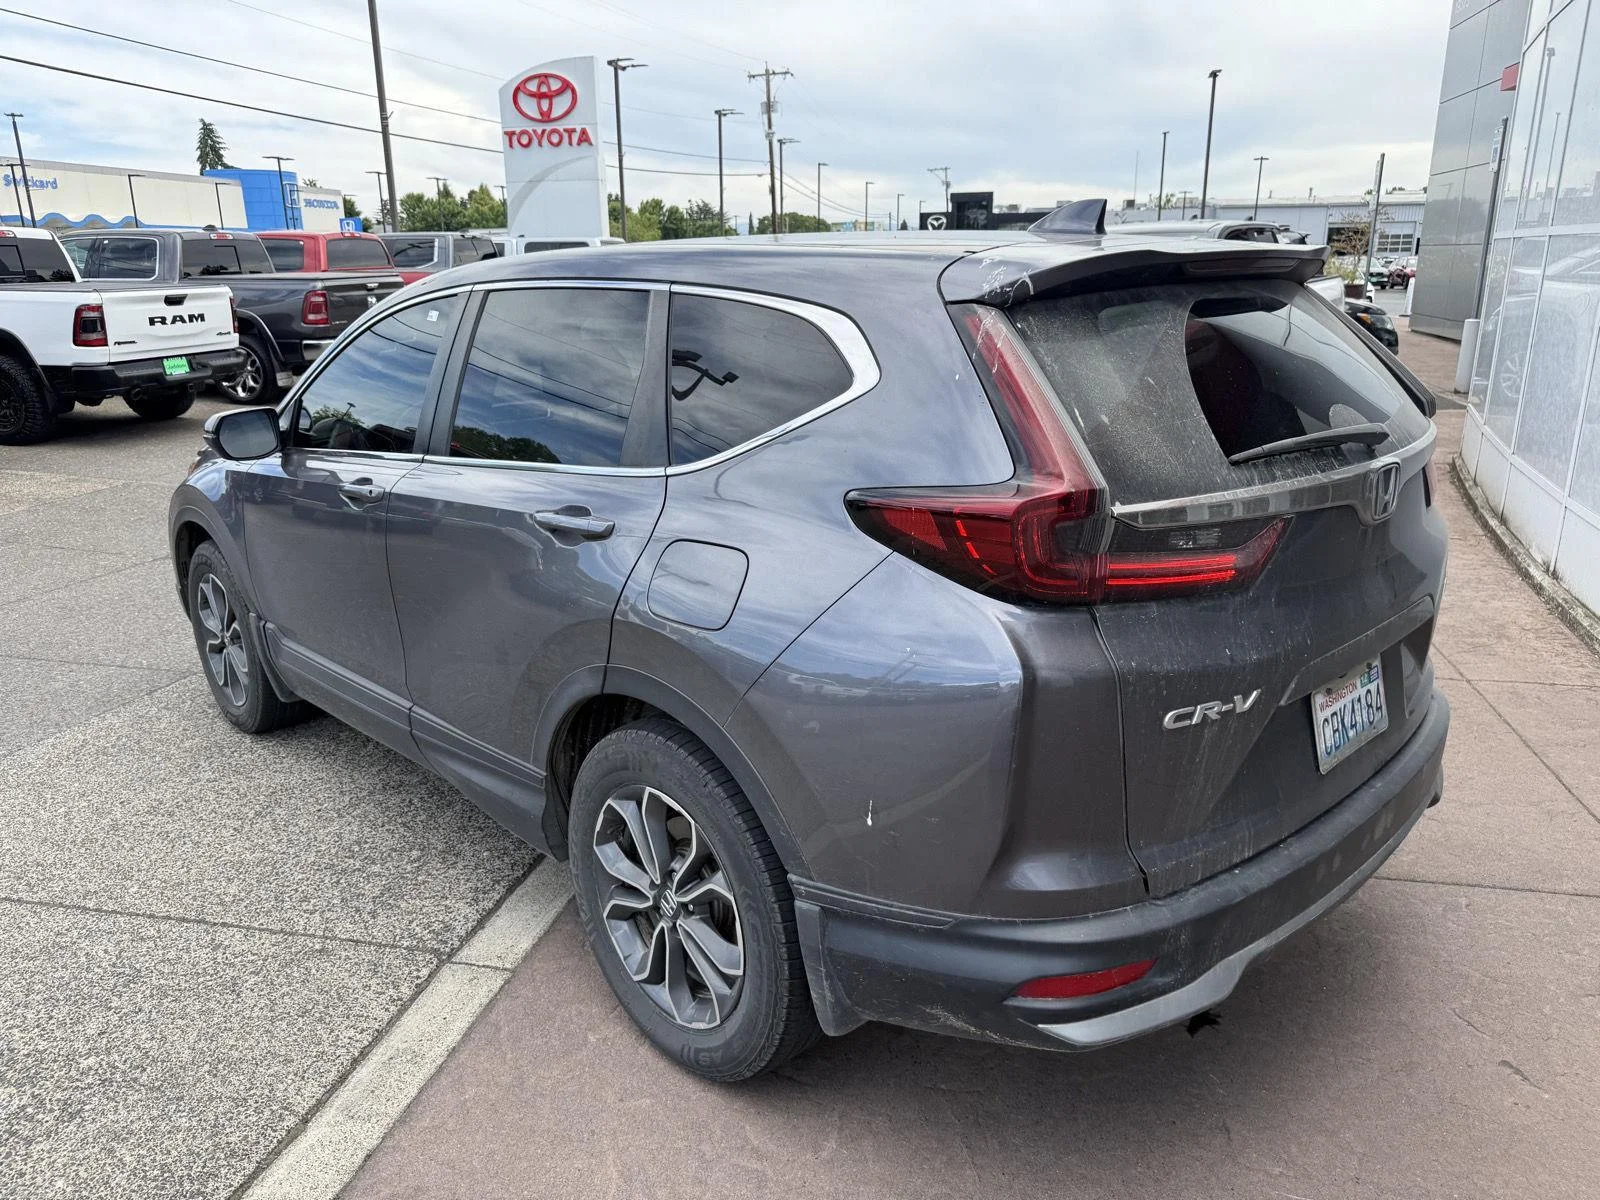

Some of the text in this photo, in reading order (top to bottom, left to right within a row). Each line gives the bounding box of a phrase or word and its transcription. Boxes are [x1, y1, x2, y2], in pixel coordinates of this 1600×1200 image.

[504, 127, 593, 149] TOYOTA
[148, 313, 206, 326] RAM
[1163, 689, 1262, 730] CR-V
[1318, 680, 1358, 712] WASHINGTON
[1321, 682, 1385, 757] CBK4184
